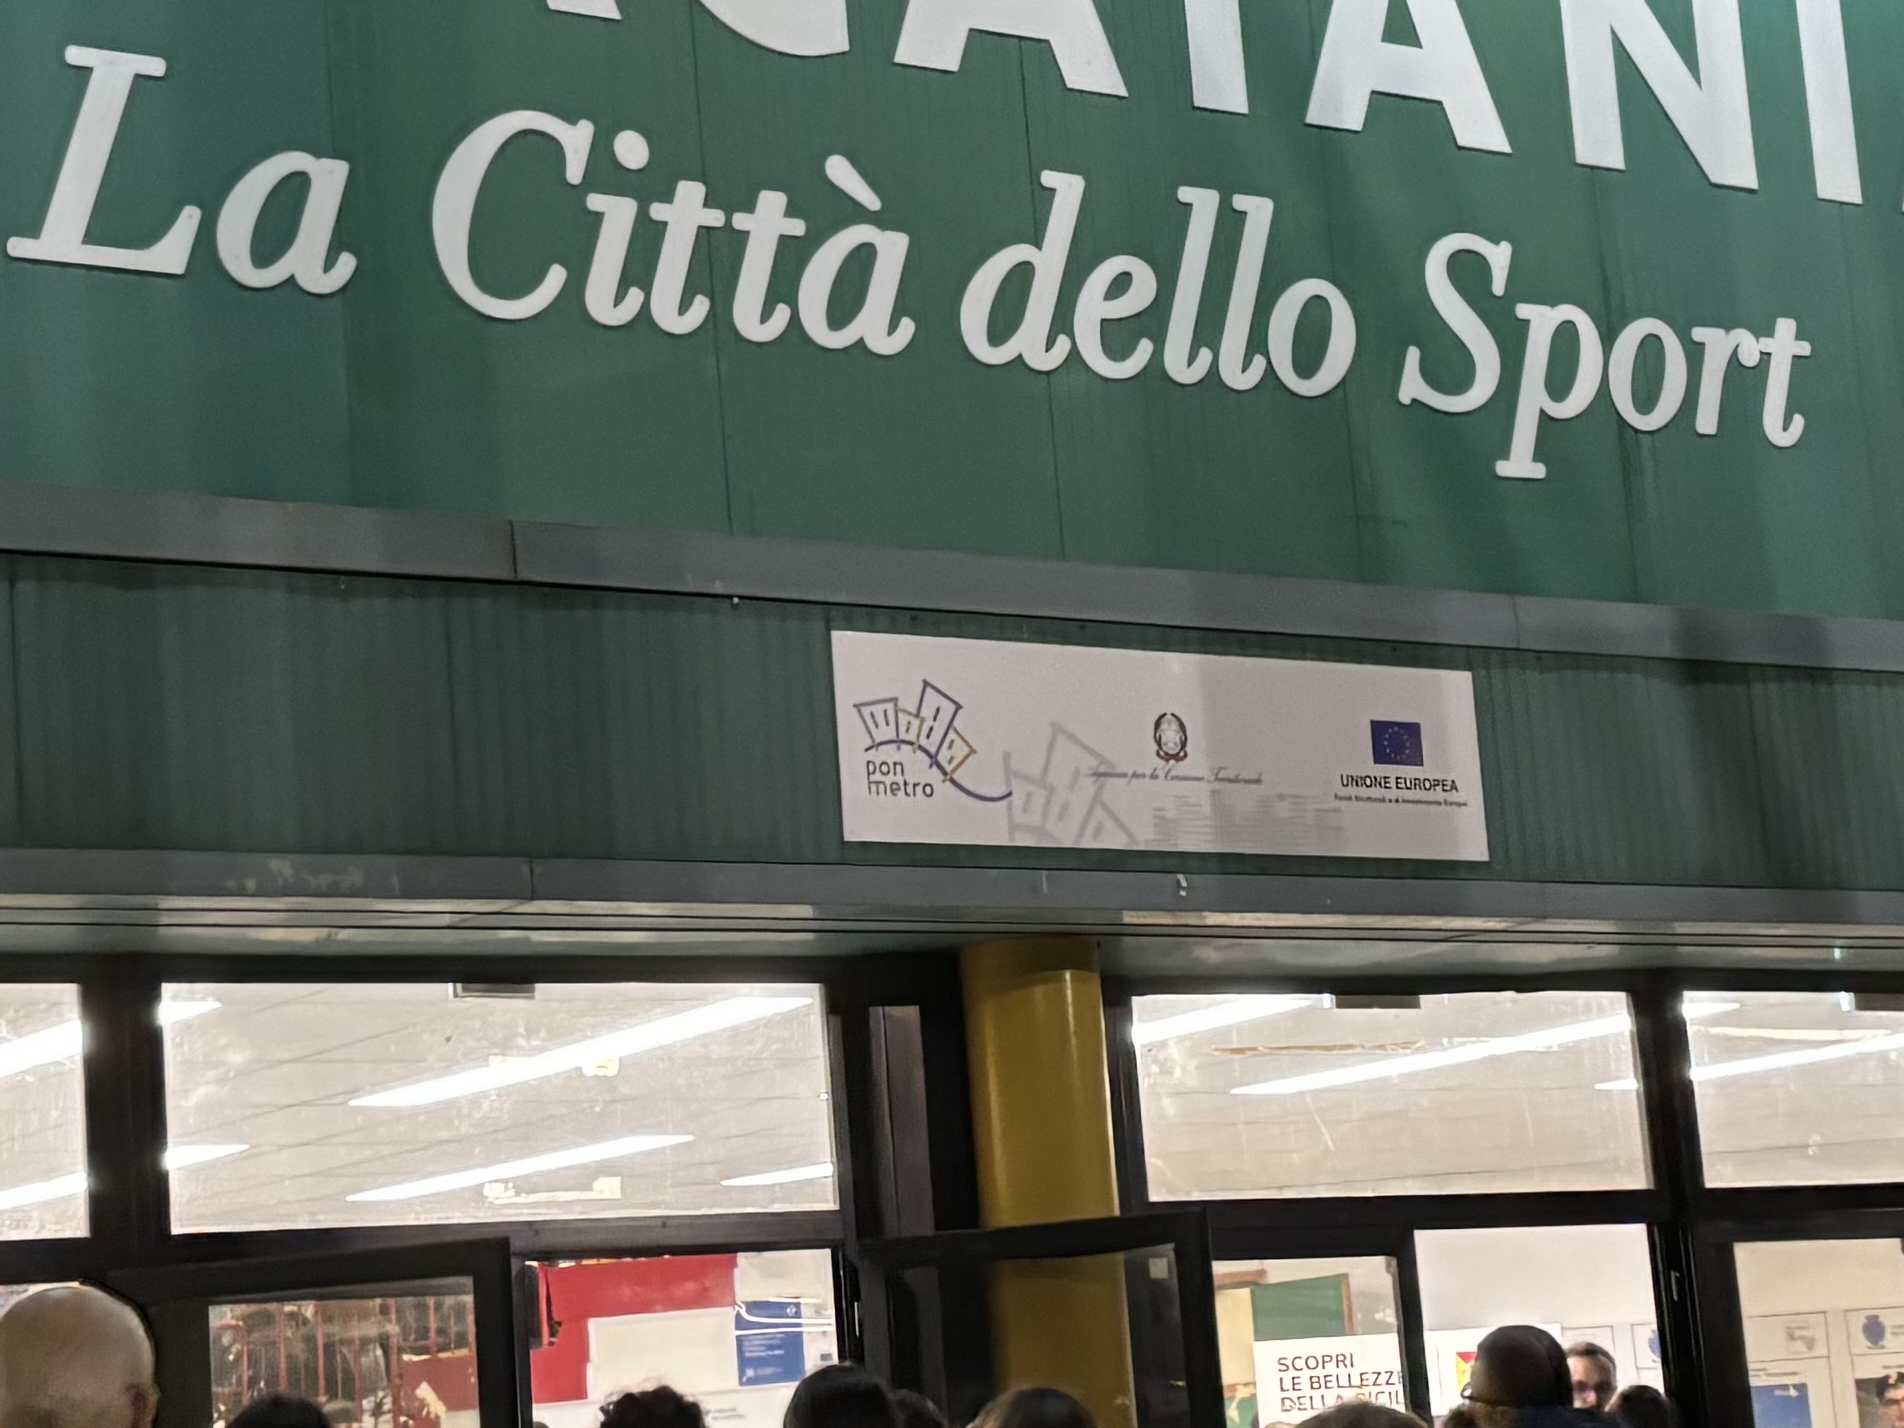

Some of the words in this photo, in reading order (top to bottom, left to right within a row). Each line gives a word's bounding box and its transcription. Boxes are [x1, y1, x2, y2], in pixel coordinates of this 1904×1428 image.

[7, 45, 357, 294] La
[432, 110, 915, 356] Città
[960, 170, 1357, 397] dello
[1398, 233, 1812, 479] Sport
[866, 760, 904, 781] pon
[868, 777, 934, 798] metro
[1340, 773, 1392, 790] UNIONE
[1395, 776, 1459, 793] EUROPEA
[1277, 1353, 1354, 1372] SCOPRI
[1279, 1376, 1302, 1392] LE
